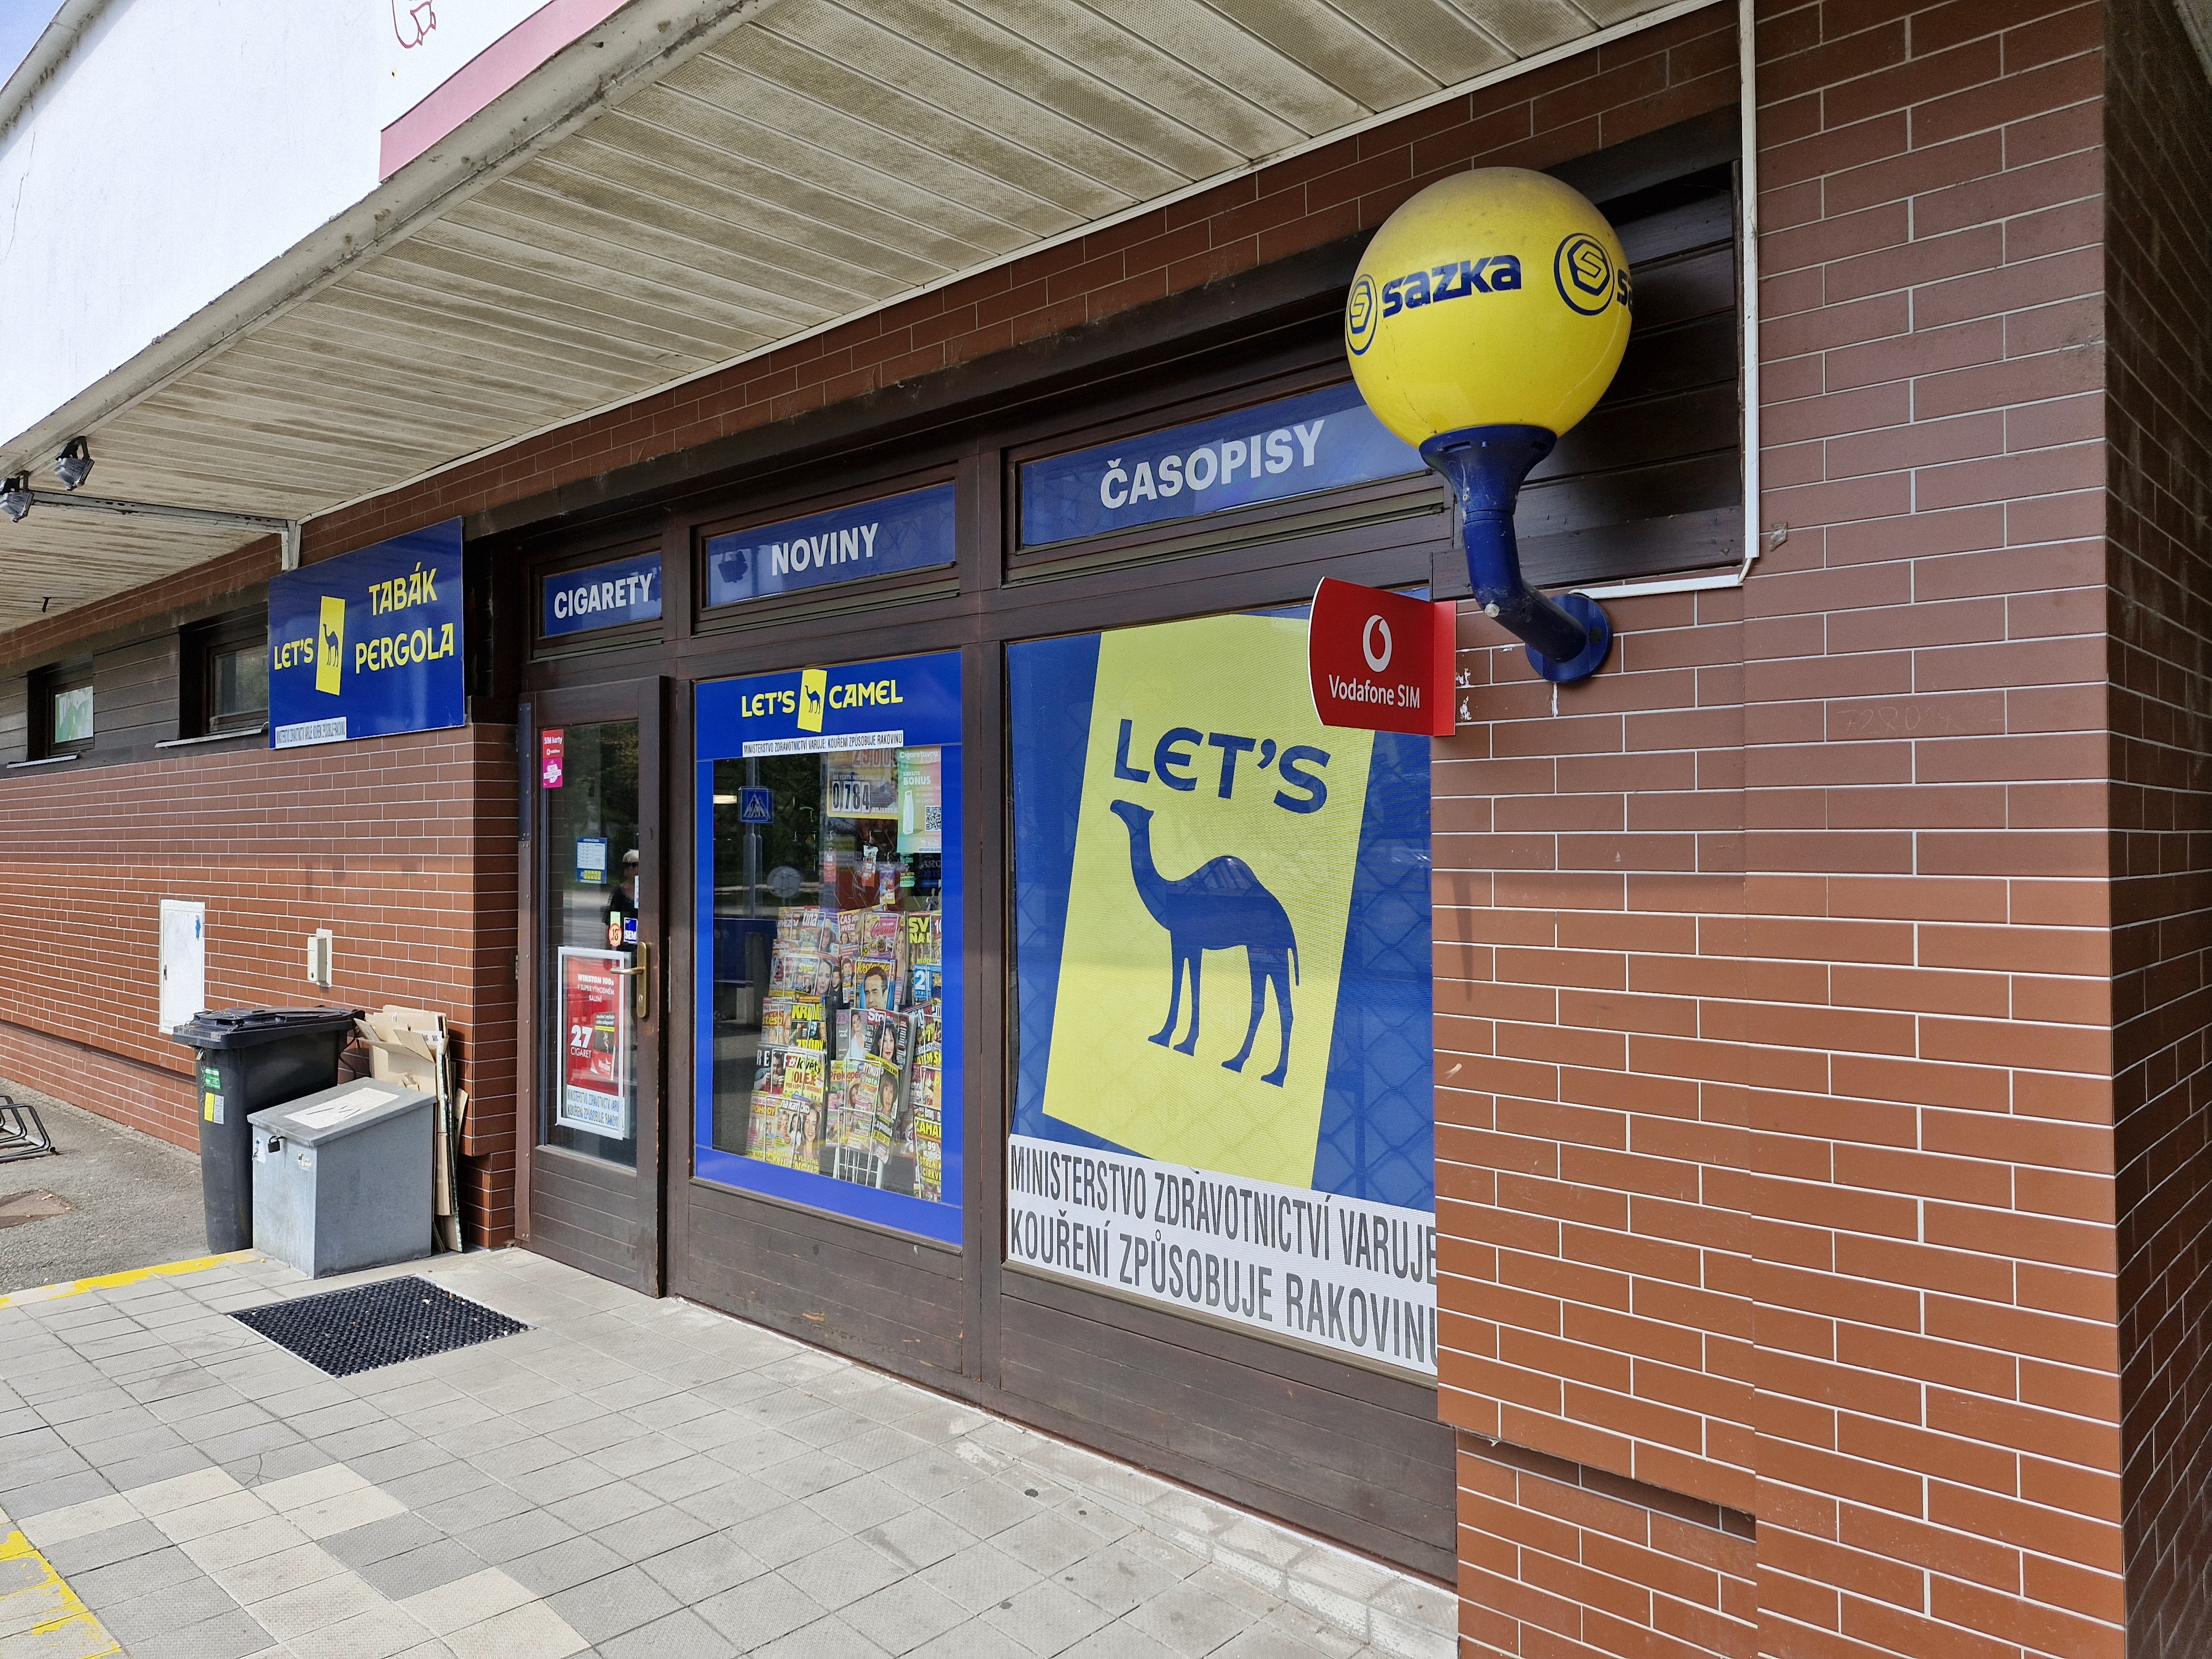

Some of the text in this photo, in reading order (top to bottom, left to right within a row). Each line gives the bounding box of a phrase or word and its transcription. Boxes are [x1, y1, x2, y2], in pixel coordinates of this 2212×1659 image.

[1100, 419, 1325, 510] ČASOPISY
[771, 523, 879, 576] NOVINY
[368, 562, 437, 616] TABÁK
[554, 573, 653, 619] CIGARETY
[356, 623, 454, 674] PERGOLA
[829, 679, 904, 709] CAMEL
[1328, 674, 1420, 709] Vodafone SIM
[744, 743, 774, 754] MINISTERSTVO
[775, 738, 807, 752] ZDRAVOTNICTVÍ
[828, 735, 848, 748] KOUŘENÍ
[849, 734, 876, 747] ZPŮSOBUJE
[877, 733, 902, 745] RAKOVINU
[899, 751, 938, 760] Cigaretovna
[903, 776, 931, 785] BONUS
[577, 974, 614, 985] WINSTON 100s
[570, 1024, 593, 1048] 27
[570, 1047, 592, 1058] CIGARET
[1011, 1144, 1437, 1285] MINISTERSTVO ZDRAVOTNICTVÍ VARUJE
[1011, 1208, 1111, 1279] KOUŘENÍ
[1119, 1229, 1272, 1322] ZPŮSOBUJE
